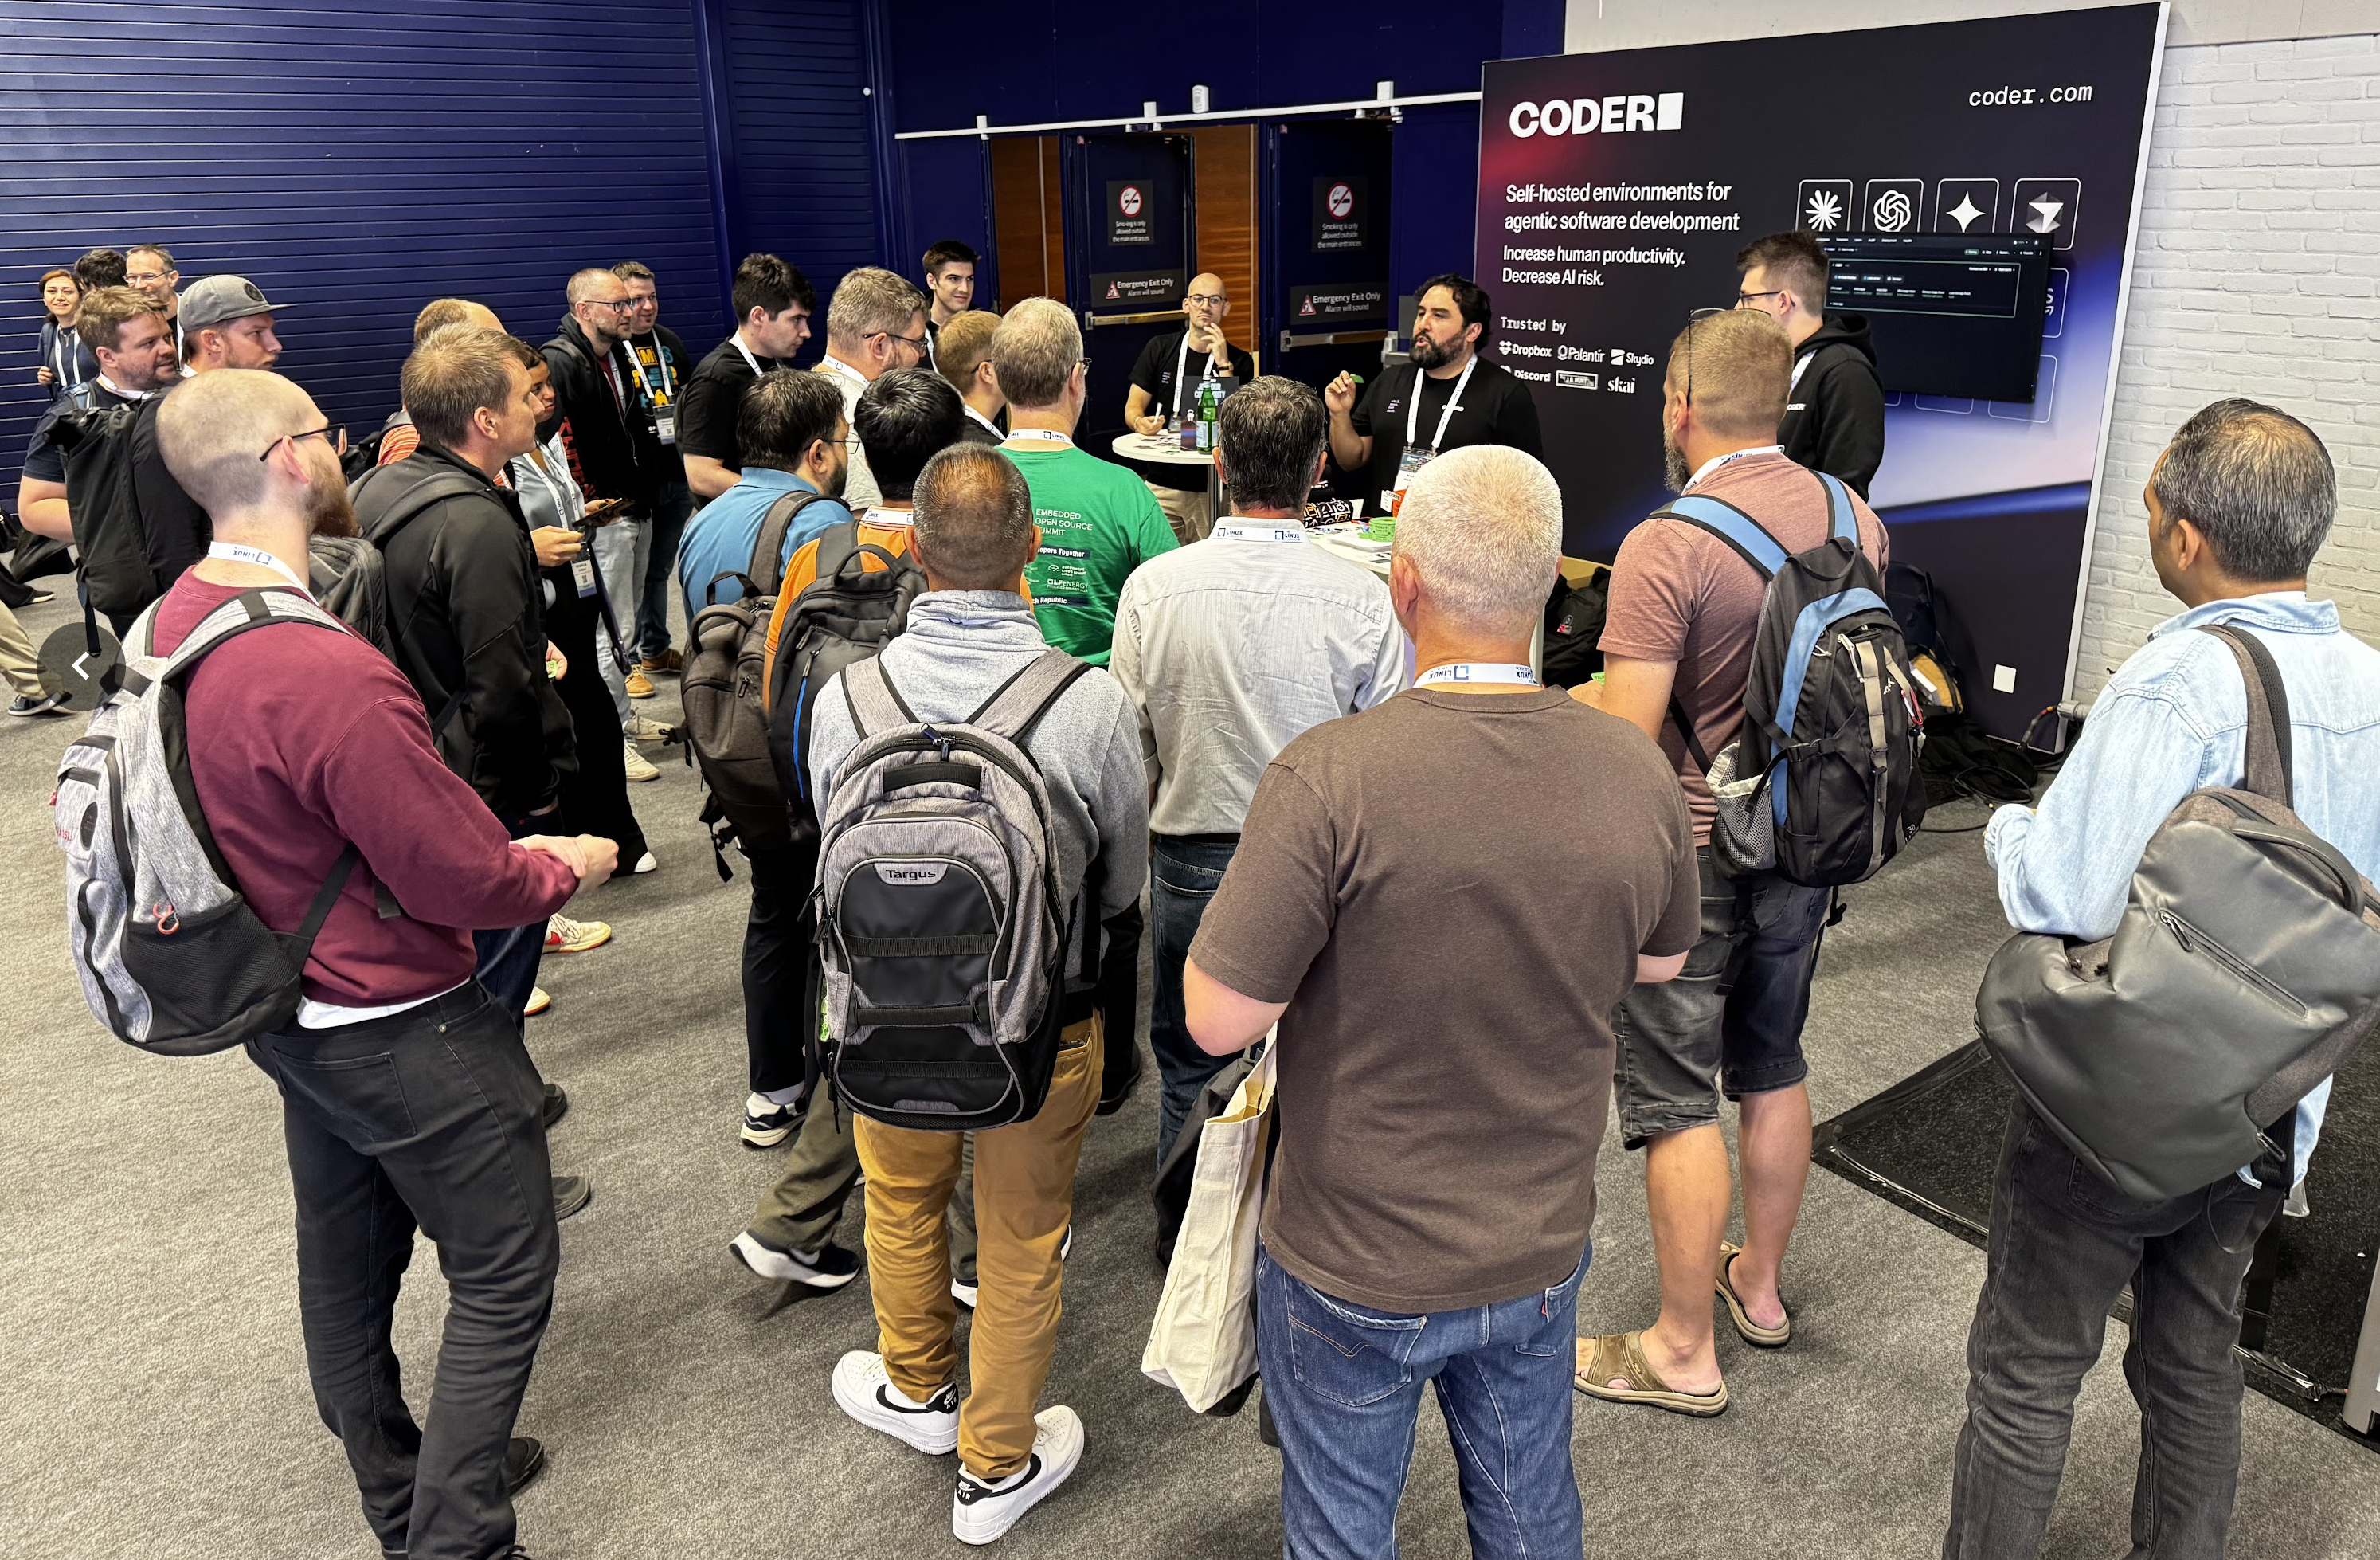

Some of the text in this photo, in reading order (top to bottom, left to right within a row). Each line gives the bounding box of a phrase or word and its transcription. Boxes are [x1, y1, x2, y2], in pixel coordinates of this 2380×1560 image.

[1968, 85, 2092, 107] coder.com
[1509, 94, 1656, 139] CODER
[1505, 181, 1732, 202] Self-hosted environments for
[1504, 210, 1740, 234] agentic software development
[1503, 245, 1686, 268] Increase human productivity.
[1117, 280, 1149, 289] Emergency
[1161, 278, 1173, 287] Only
[1502, 267, 1604, 286] Decrease AI risk.
[1313, 292, 1381, 304] Emergency Exit Only
[1501, 316, 1567, 335] Trusted by
[1513, 343, 1552, 358] Dropbox
[1568, 347, 1606, 363] Palantir
[1626, 351, 1654, 367] Skydio
[1607, 376, 1636, 394] skai
[1035, 508, 1082, 519] EMBEDDED
[1035, 517, 1093, 531] OPEN SOURCE
[233, 550, 256, 559] LINUX
[1058, 547, 1085, 557] Together
[1428, 670, 1452, 680] LINUX
[885, 869, 936, 880] Targus
[957, 1489, 971, 1500] AIR
